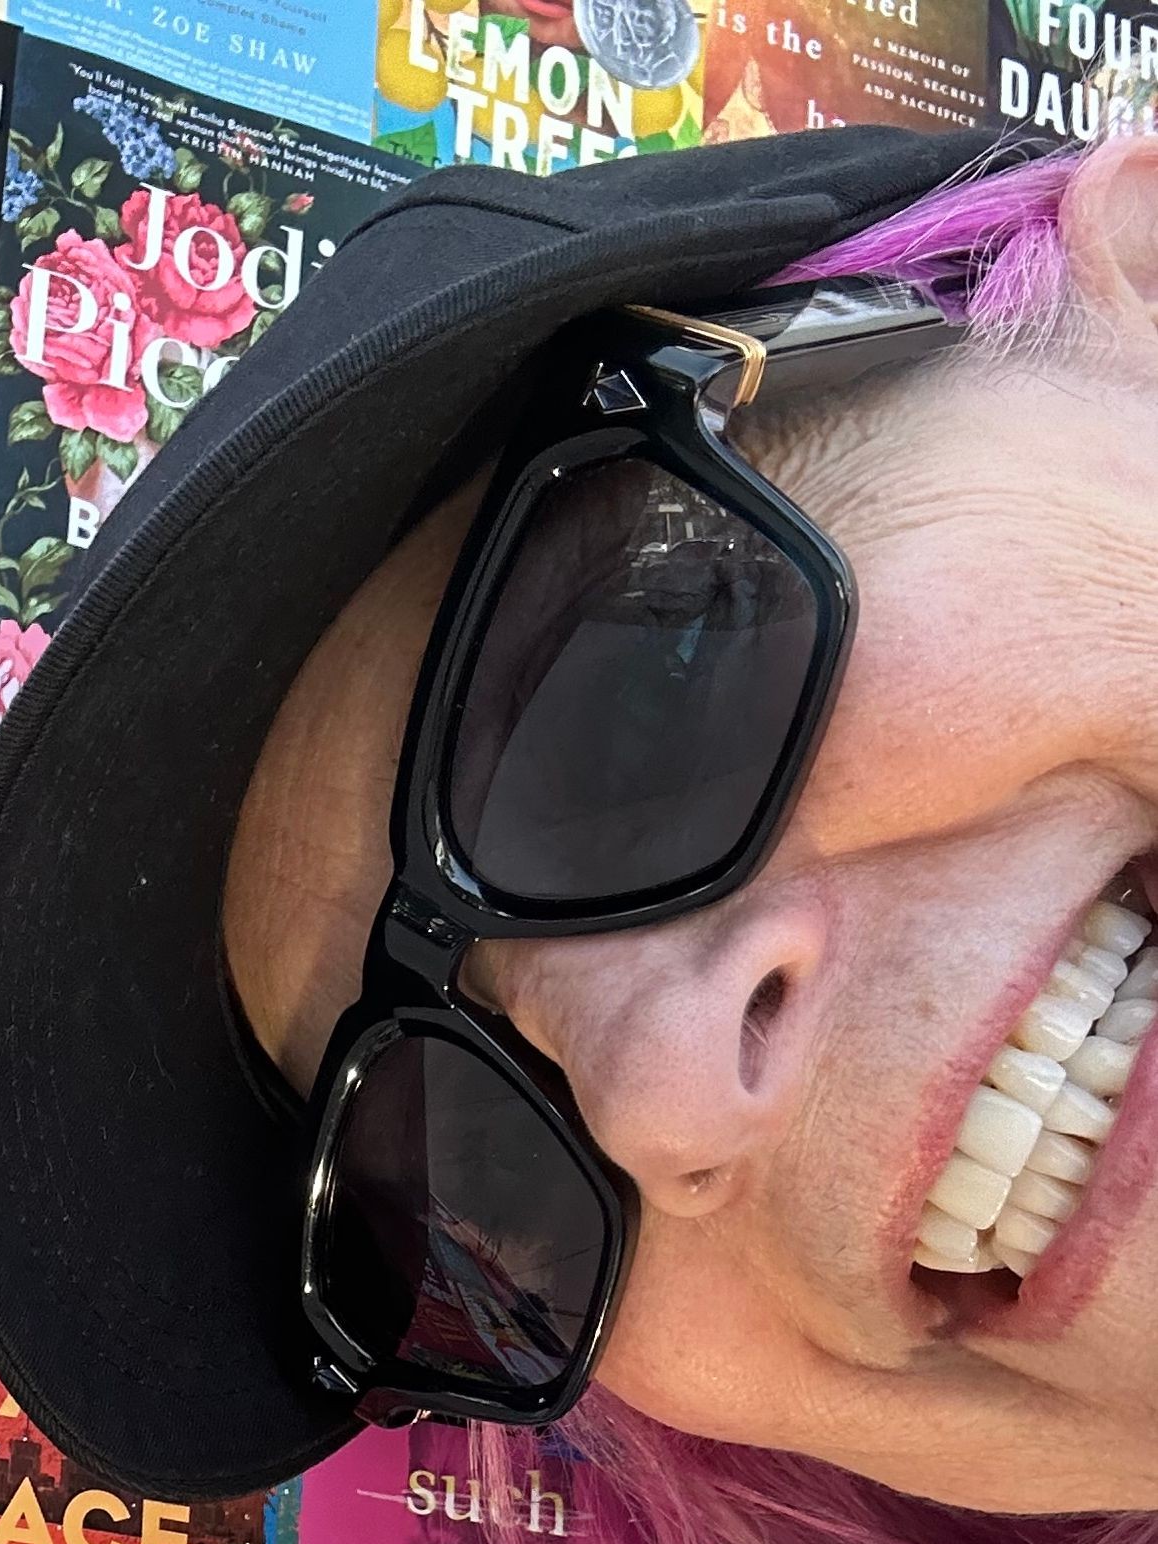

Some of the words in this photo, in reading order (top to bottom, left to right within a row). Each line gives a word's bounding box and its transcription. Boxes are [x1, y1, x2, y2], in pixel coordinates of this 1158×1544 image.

[152, 5, 210, 44] ZOE
[228, 33, 318, 75] SHAW
[766, 20, 823, 60] the
[888, 40, 946, 72] MEMOIR
[408, 0, 637, 138] LEMON
[900, 93, 977, 128] SACRIFICE
[922, 77, 987, 108] SECRETS
